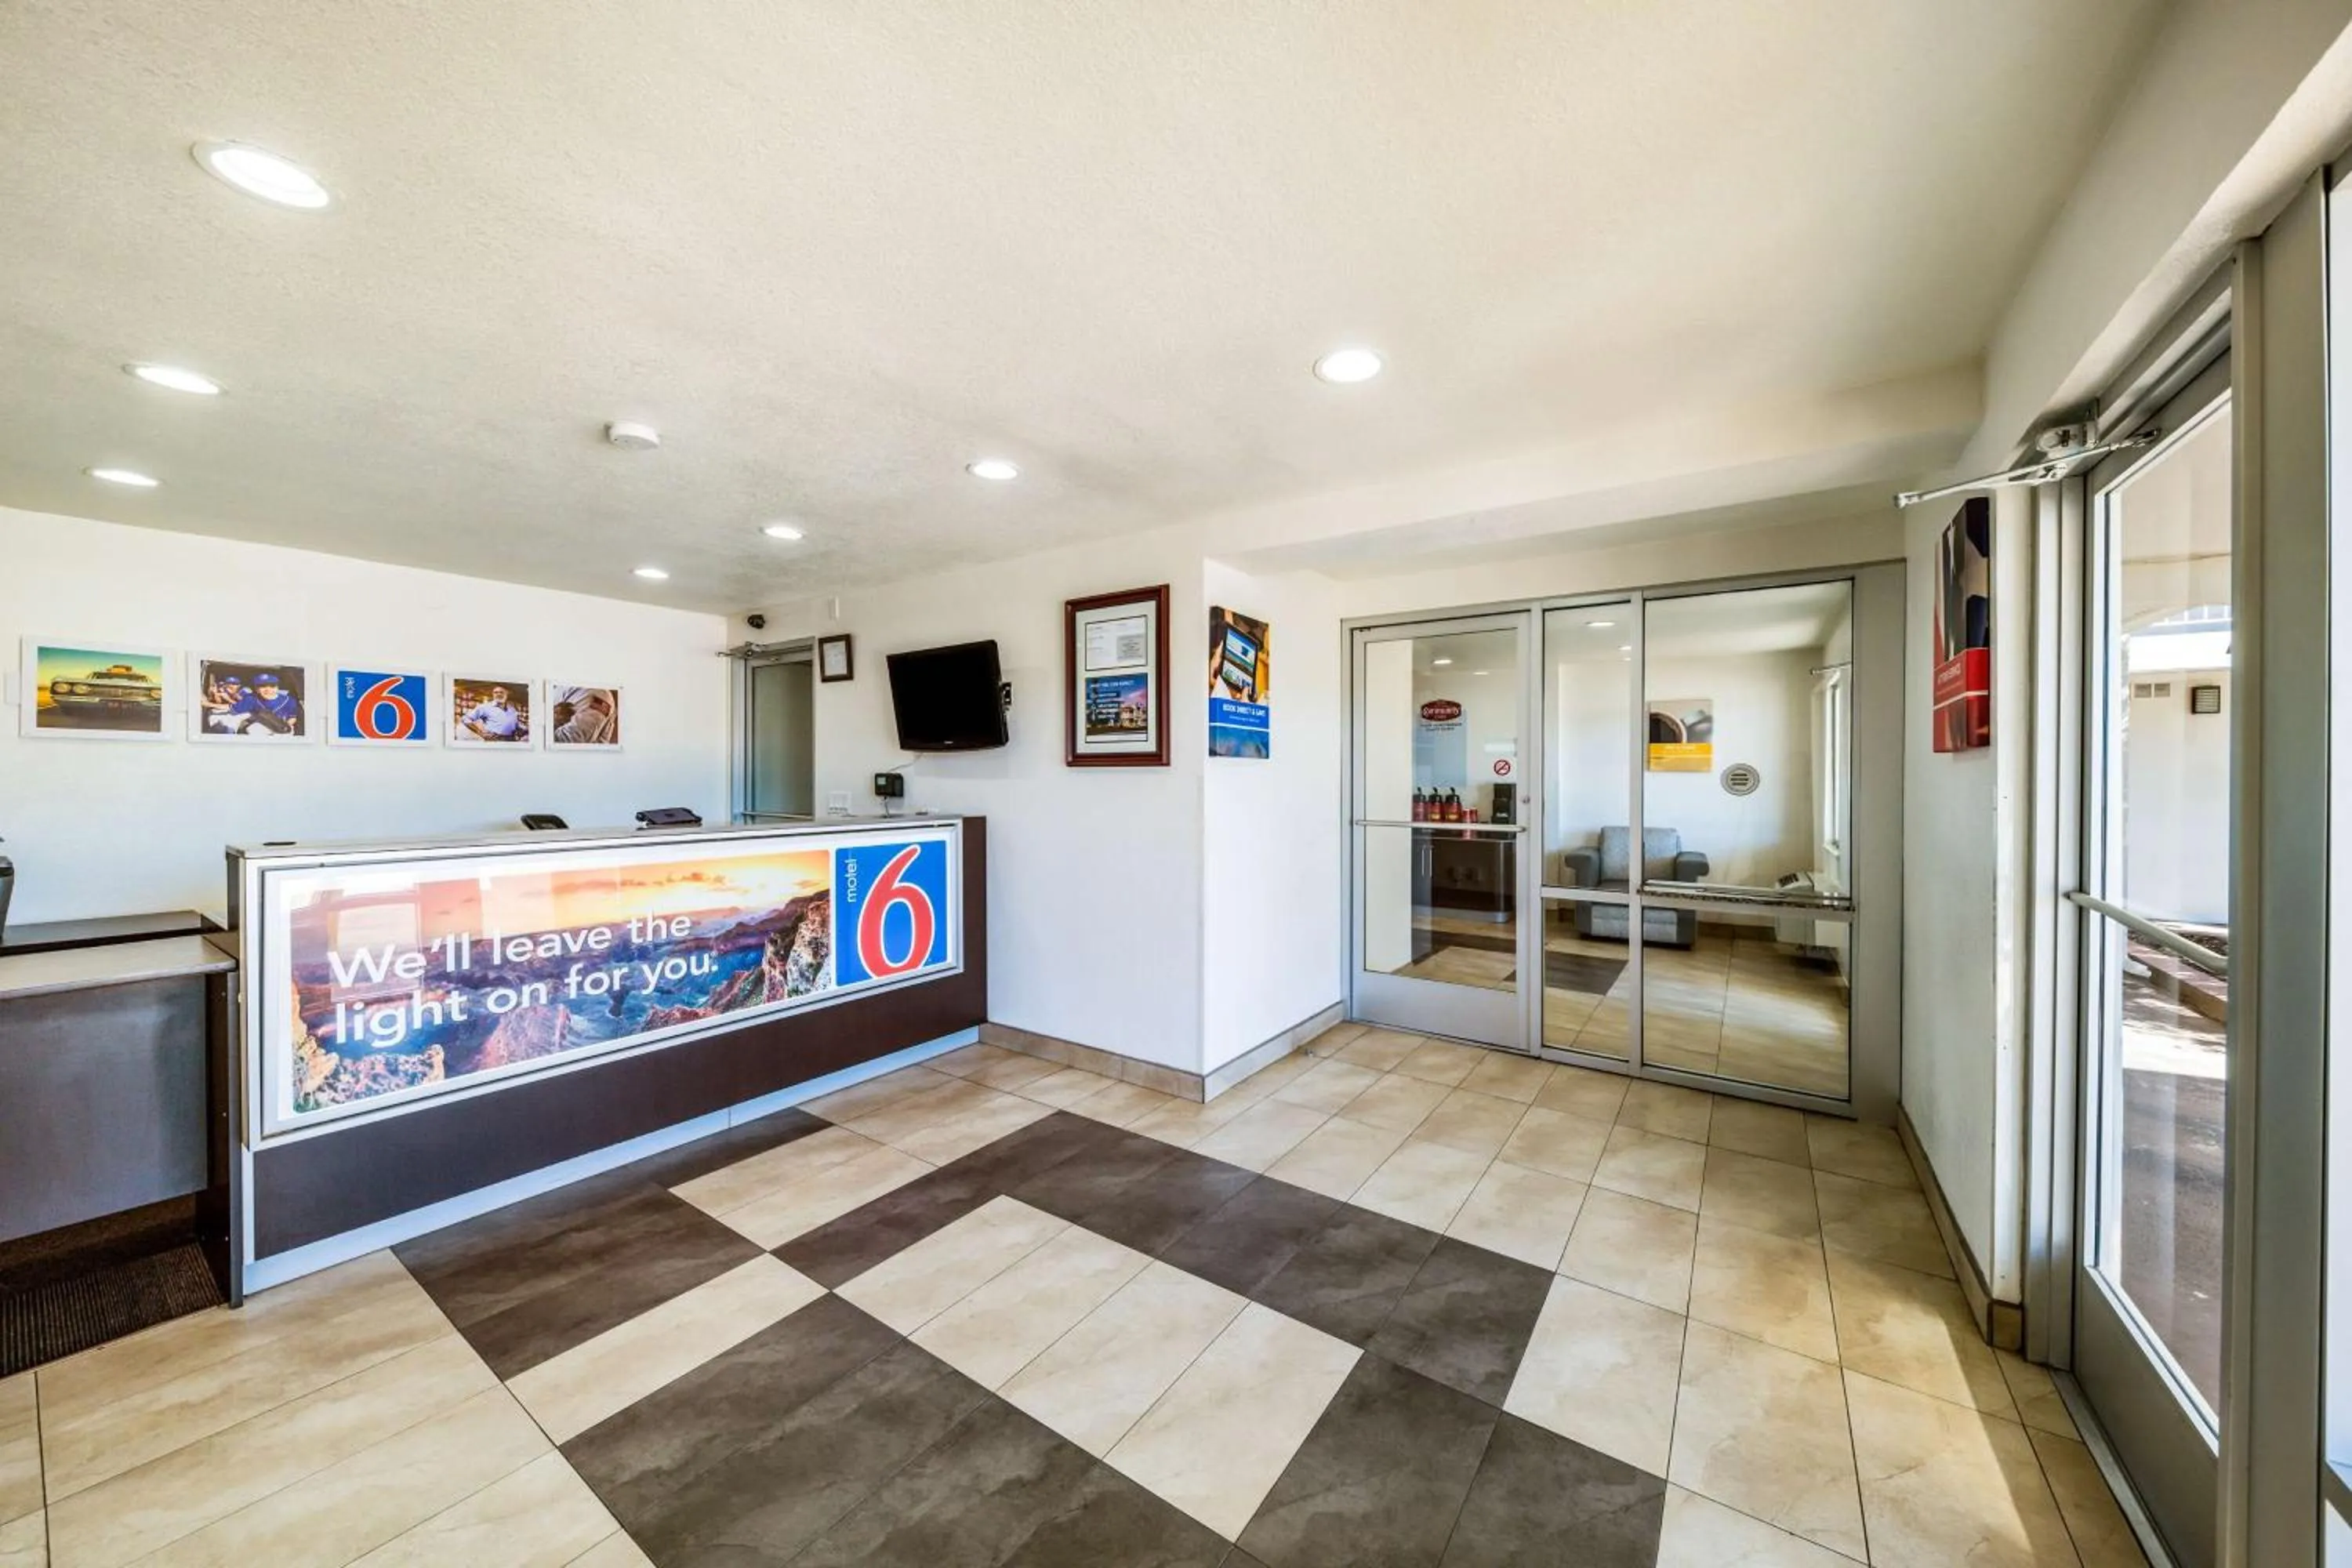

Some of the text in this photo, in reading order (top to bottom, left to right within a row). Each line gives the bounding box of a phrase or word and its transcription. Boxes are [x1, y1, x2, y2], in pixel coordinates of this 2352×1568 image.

[354, 676, 416, 740] 6
[844, 858, 858, 903] motel
[857, 844, 935, 980] 6
[326, 910, 691, 989] We'll leave the
[336, 989, 469, 1047] light
[486, 981, 548, 1014] on
[564, 963, 628, 1000] for
